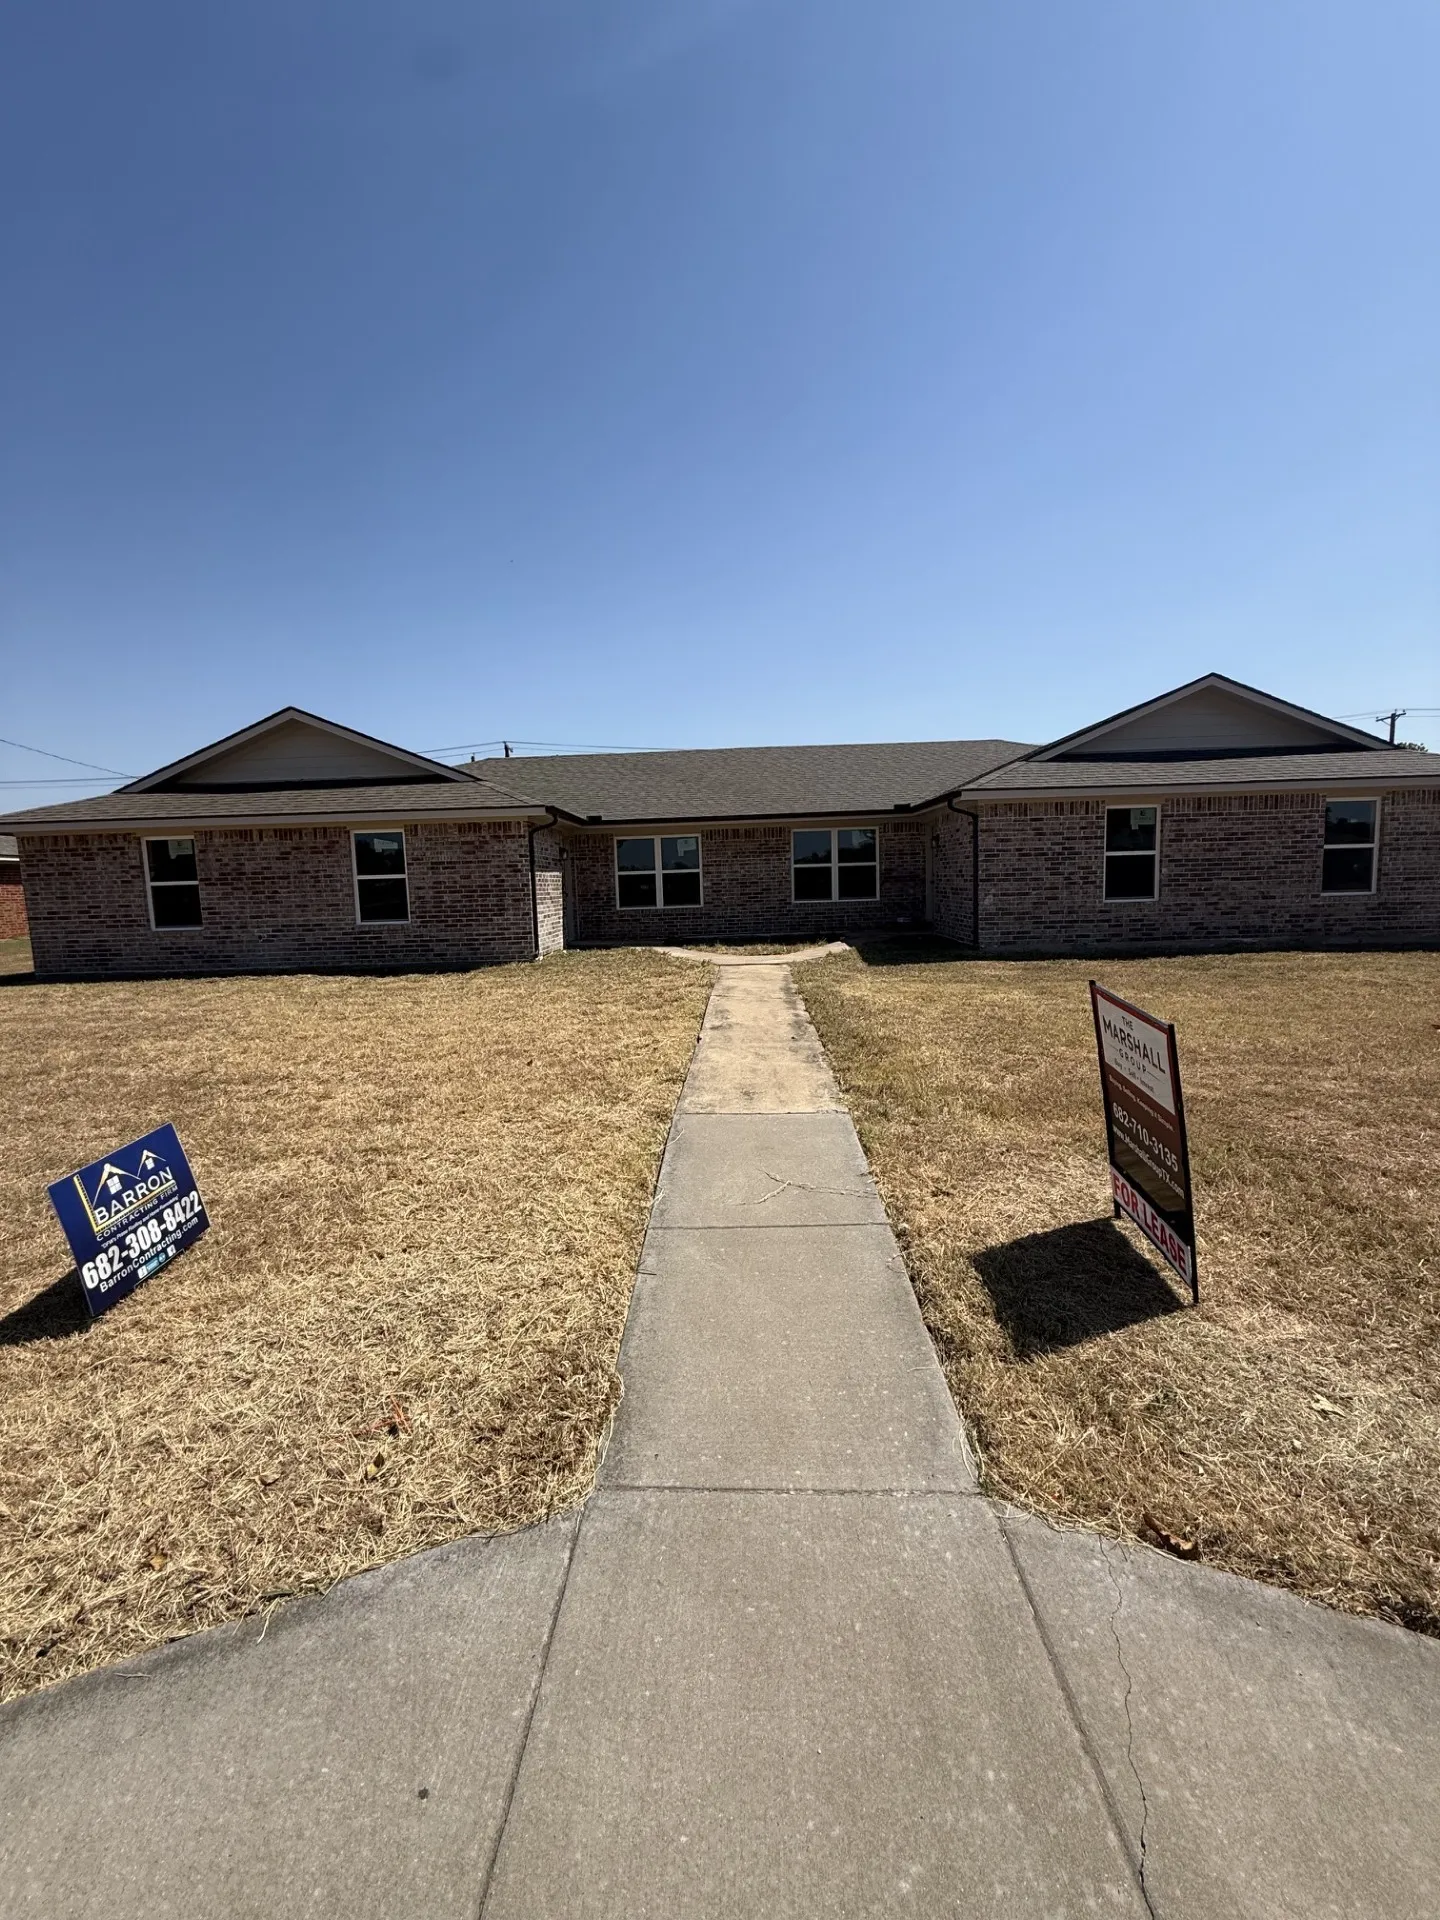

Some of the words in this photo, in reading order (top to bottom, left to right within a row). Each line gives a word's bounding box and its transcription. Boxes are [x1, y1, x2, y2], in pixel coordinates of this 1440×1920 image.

[1102, 1015, 1166, 1074] MARSHALL
[1121, 1016, 1134, 1031] THE
[1119, 1048, 1147, 1074] GROUP
[1112, 1102, 1179, 1172] 682-710-3135
[94, 1167, 174, 1225] BARRON
[96, 1199, 159, 1241] CONTRACTING
[160, 1185, 178, 1200] FIRM
[1113, 1173, 1140, 1218] FOR
[1143, 1203, 1188, 1276] LEASE
[82, 1190, 203, 1289] 682-308-8422
[99, 1216, 199, 1293] BarronContracting.com
